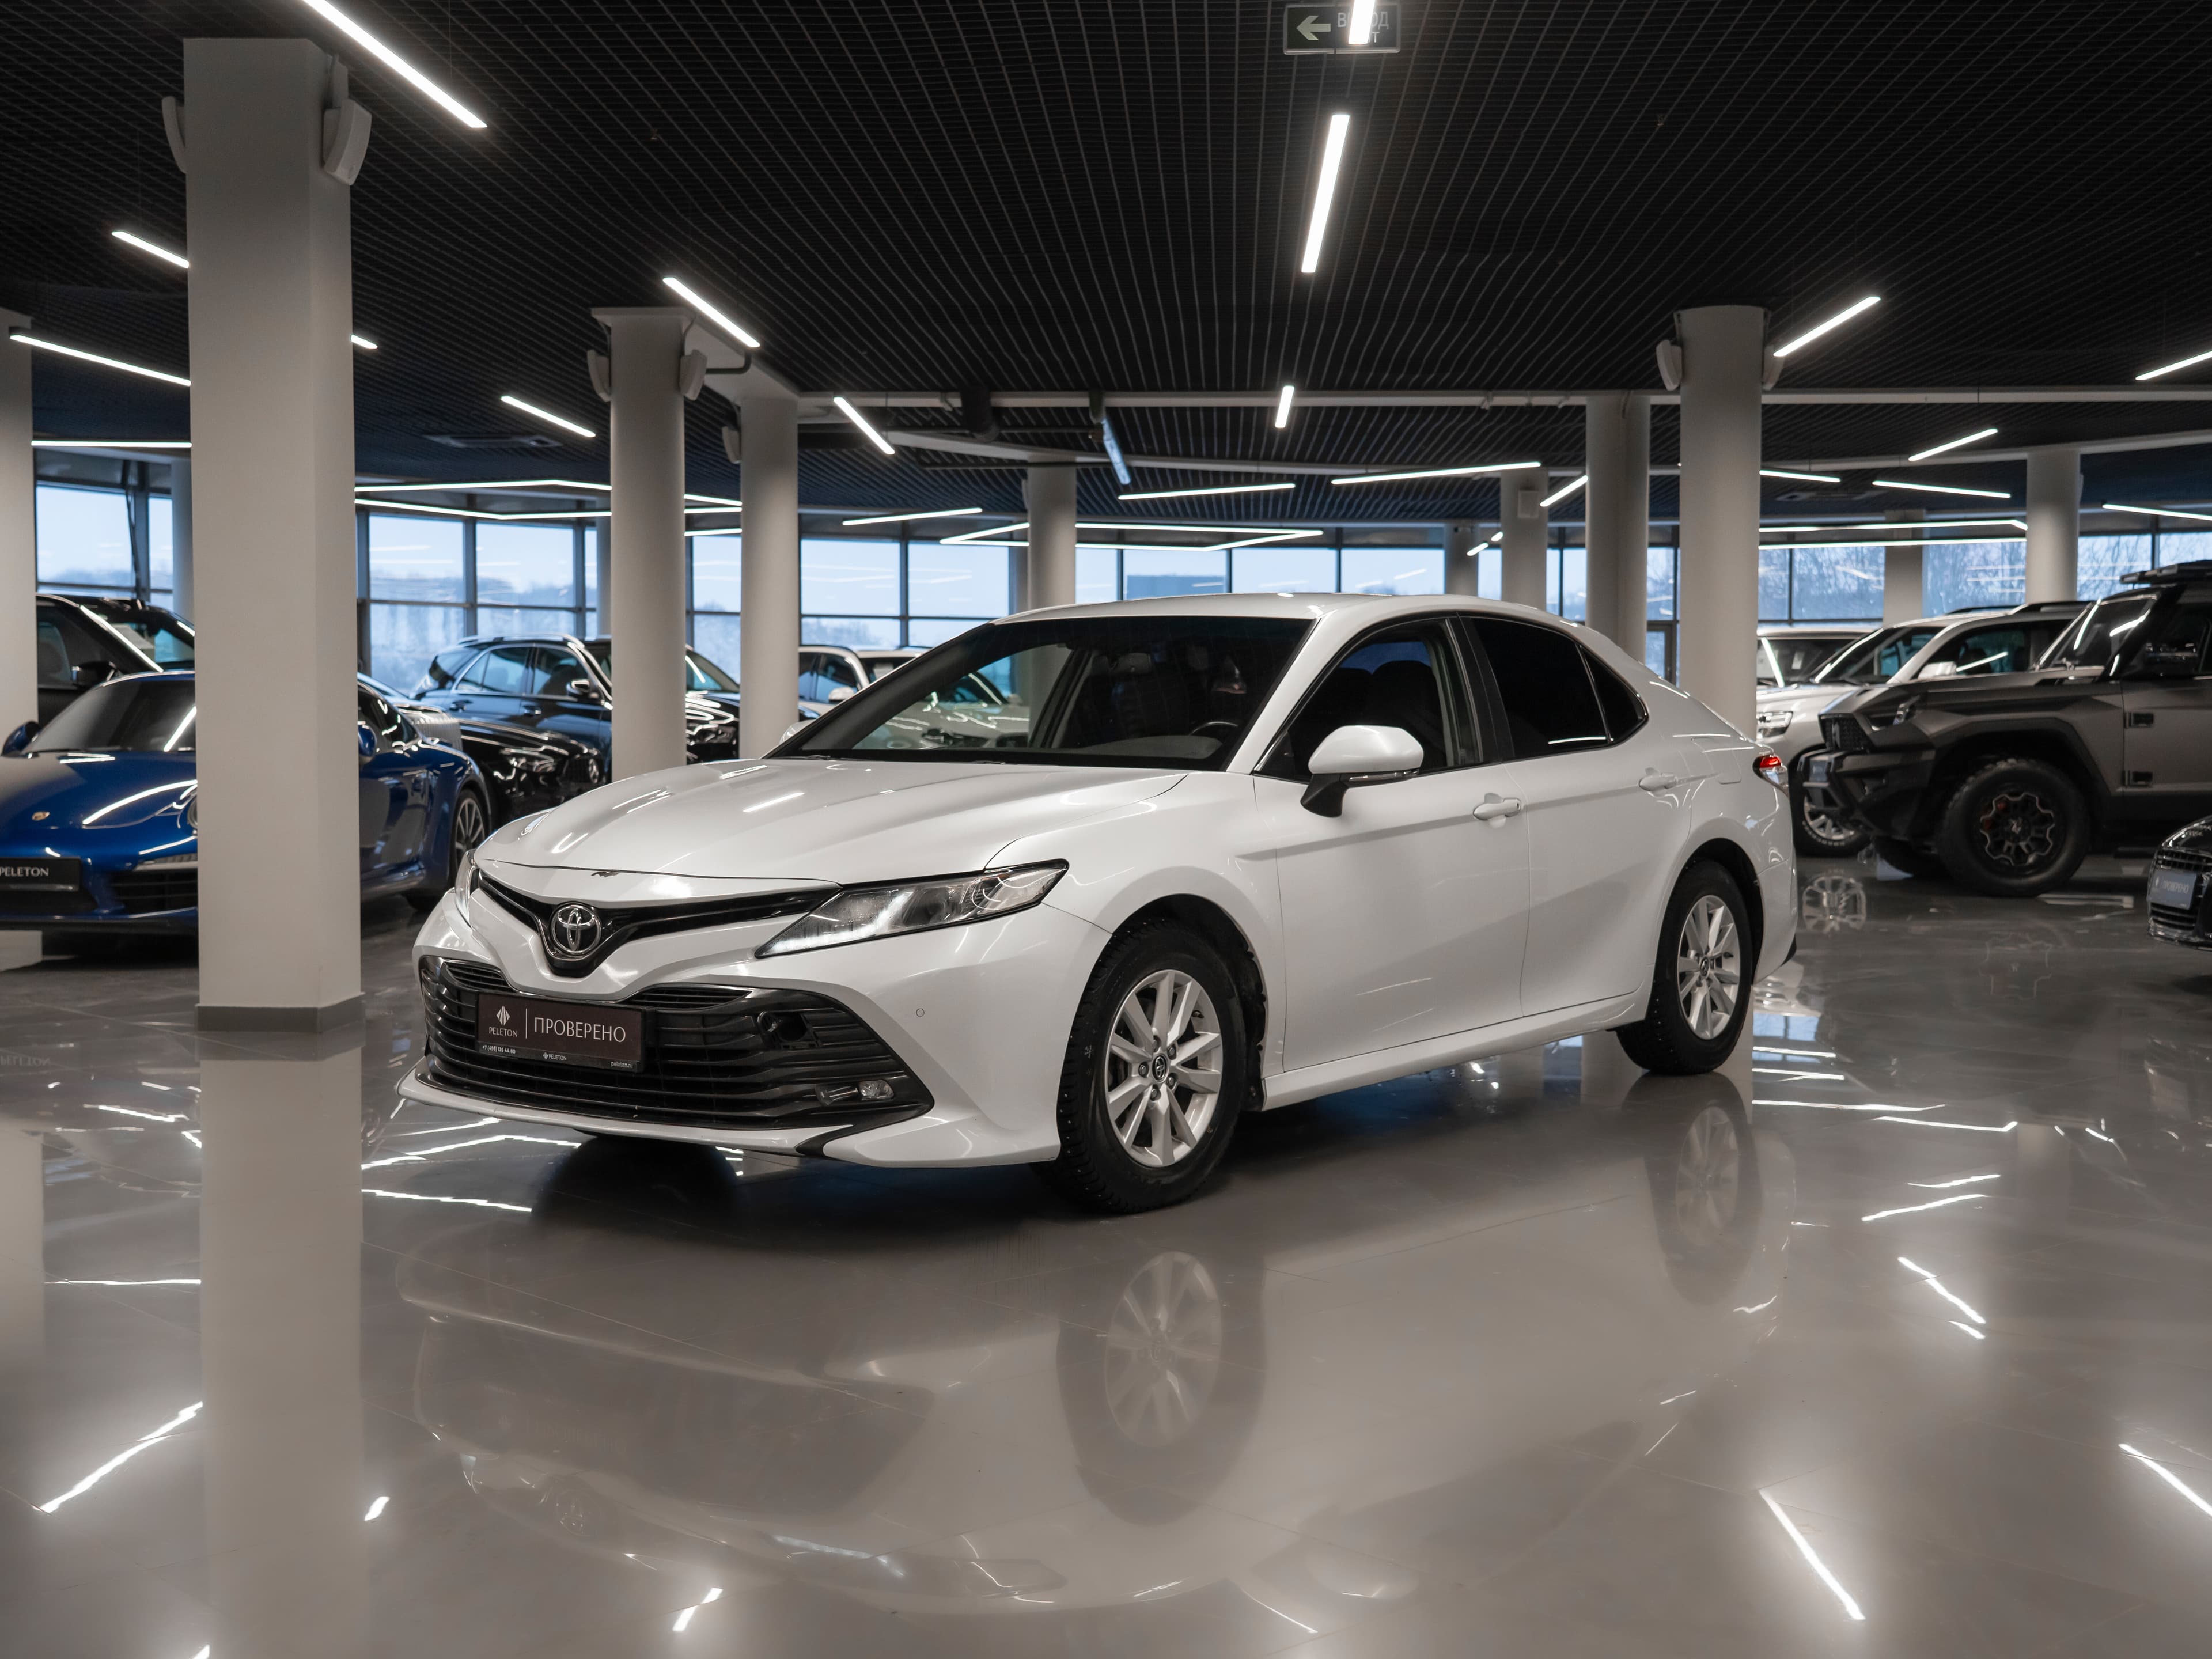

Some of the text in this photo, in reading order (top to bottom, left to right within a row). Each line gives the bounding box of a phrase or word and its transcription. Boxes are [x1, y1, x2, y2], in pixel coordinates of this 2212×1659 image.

[0, 866, 50, 877] PELETON
[488, 1027, 518, 1037] PELETON
[534, 1016, 626, 1043] ПРОВЕРЕНО
